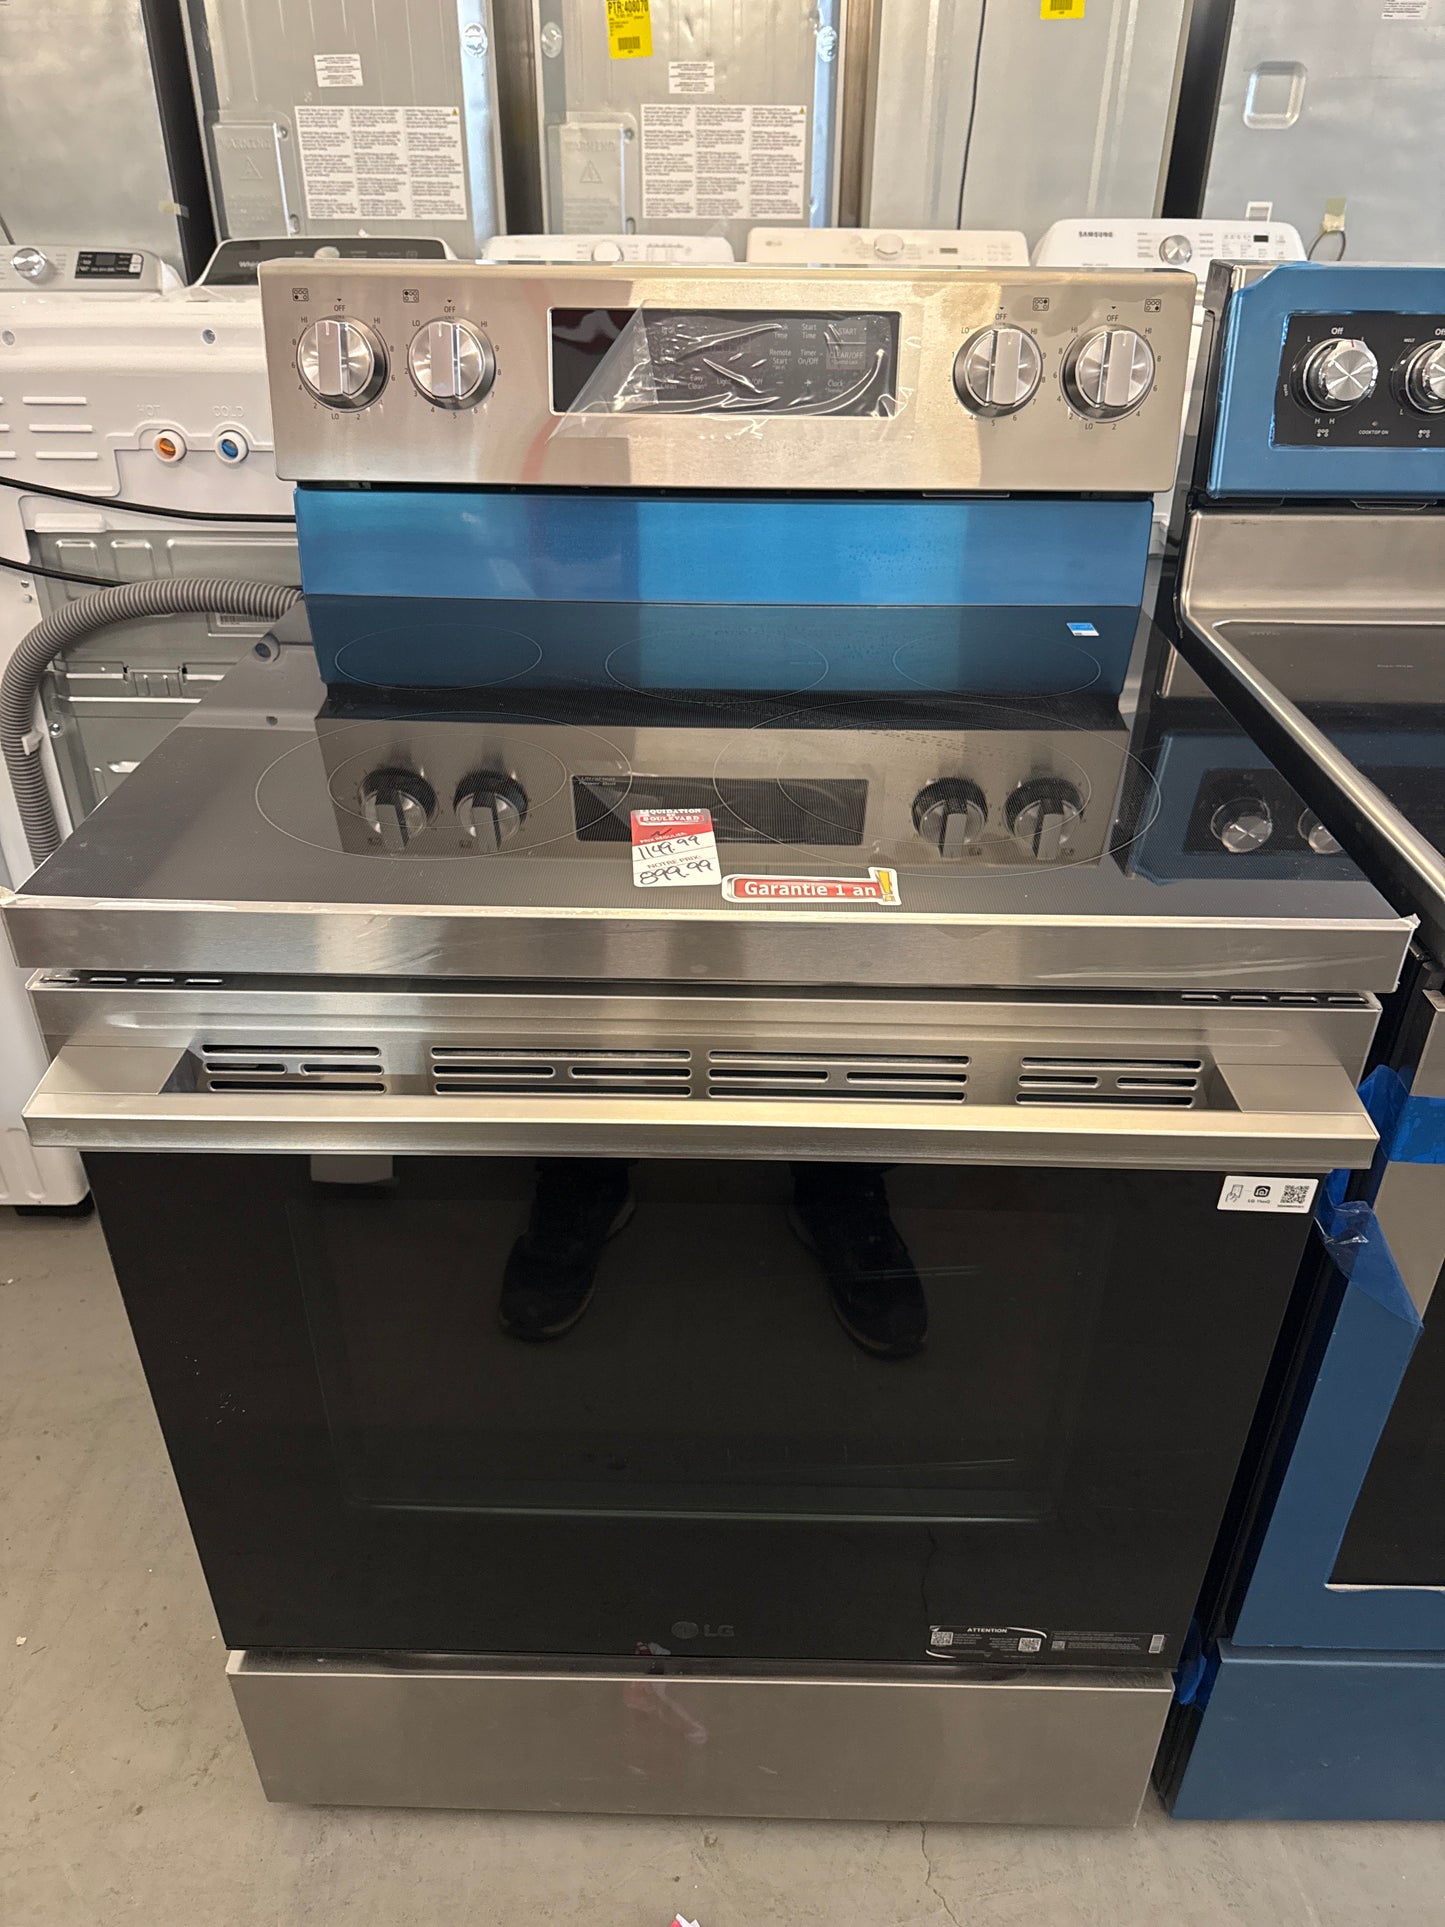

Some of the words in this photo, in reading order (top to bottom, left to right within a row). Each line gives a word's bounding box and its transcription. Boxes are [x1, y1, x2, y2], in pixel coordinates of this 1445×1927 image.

[769, 348, 792, 356] Remote
[772, 357, 788, 365] Start
[647, 859, 677, 869] NOTRE
[640, 860, 713, 885] 899.99
[744, 881, 828, 896] Garantie
[836, 884, 846, 896] 1
[853, 886, 876, 897] an
[704, 1624, 735, 1637] LG
